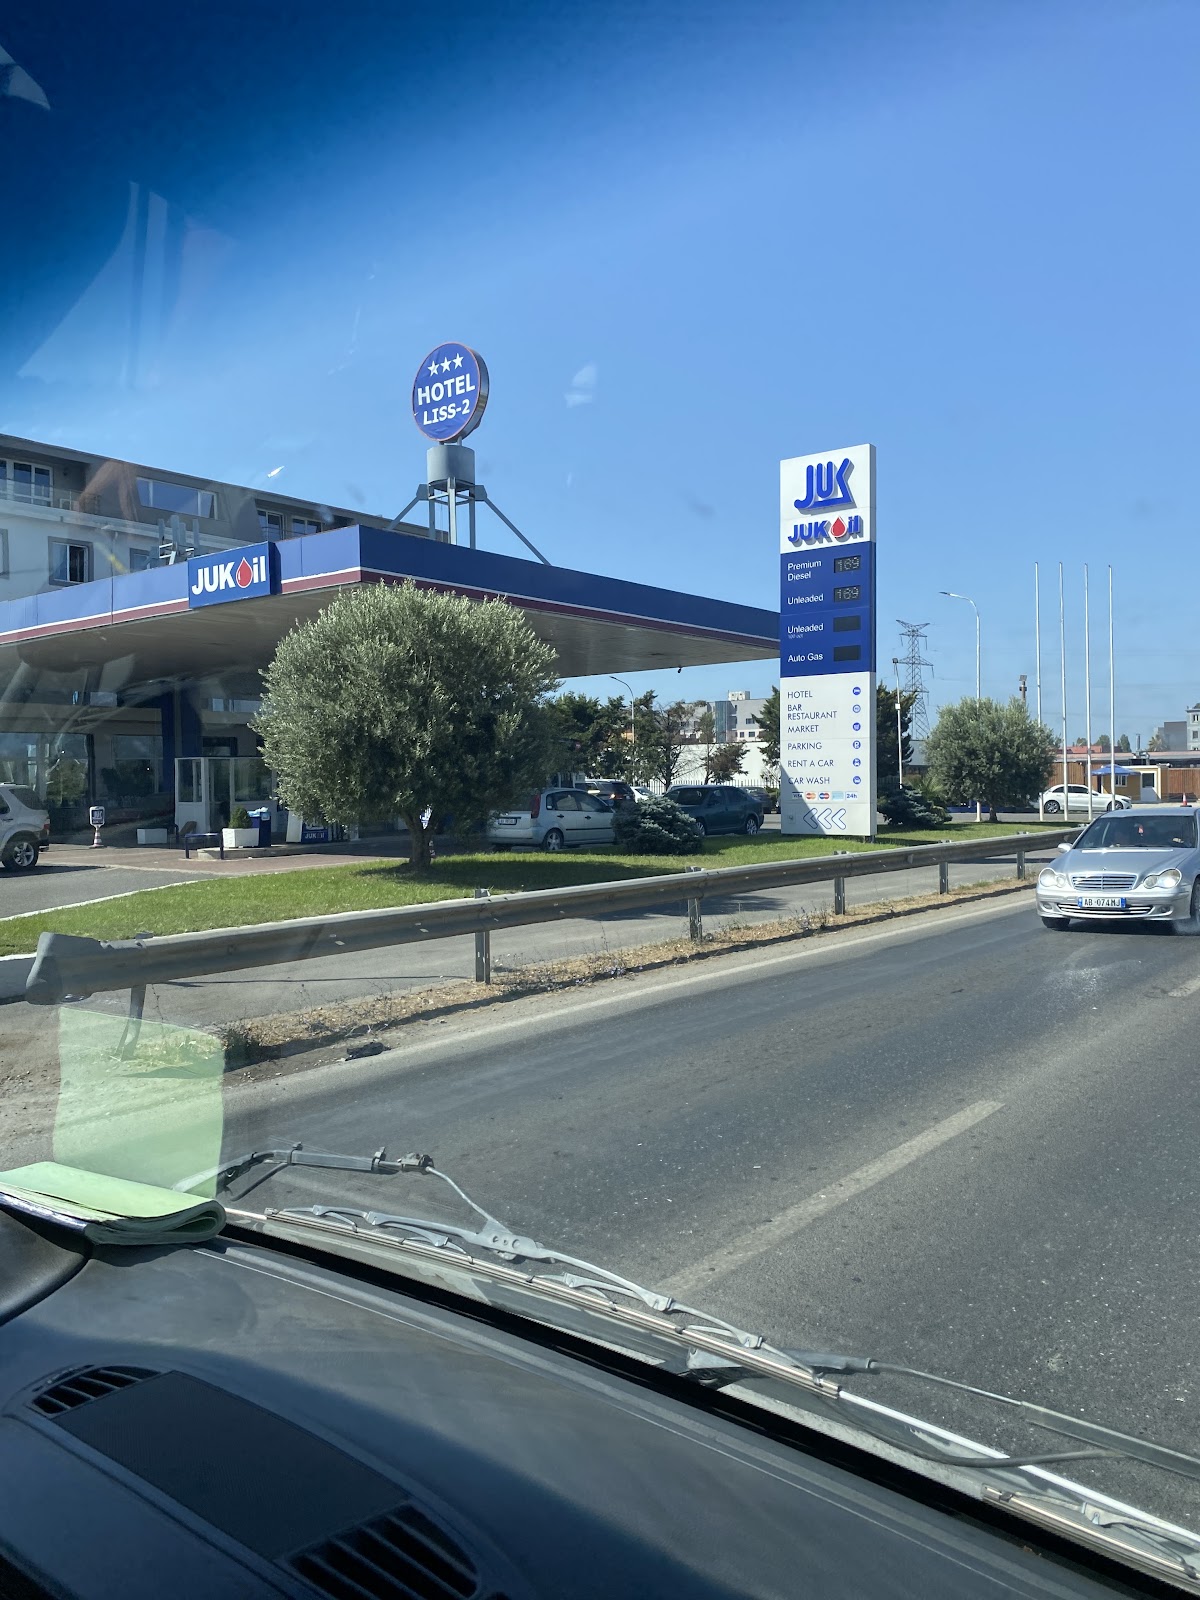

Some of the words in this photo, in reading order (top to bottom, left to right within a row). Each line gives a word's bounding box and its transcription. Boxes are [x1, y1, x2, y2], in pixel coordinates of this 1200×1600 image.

[417, 373, 476, 406] HOTEL
[423, 398, 471, 426] LISS-2
[793, 457, 853, 509] JUK
[787, 560, 822, 571] Premium
[787, 571, 812, 582] Diesel
[787, 593, 824, 605] Unleaded
[787, 623, 824, 634] Unleaded
[787, 653, 806, 663] Auto
[807, 652, 824, 662] Gas
[787, 690, 813, 699] HOTEL
[787, 704, 802, 712] BAR
[787, 711, 837, 720] RESTAURANT
[787, 725, 819, 733] MARKET
[787, 742, 822, 750] PARKING
[787, 760, 807, 768] RENT
[817, 759, 834, 767] CAR
[787, 777, 805, 785] CAR
[806, 777, 830, 785] WASH
